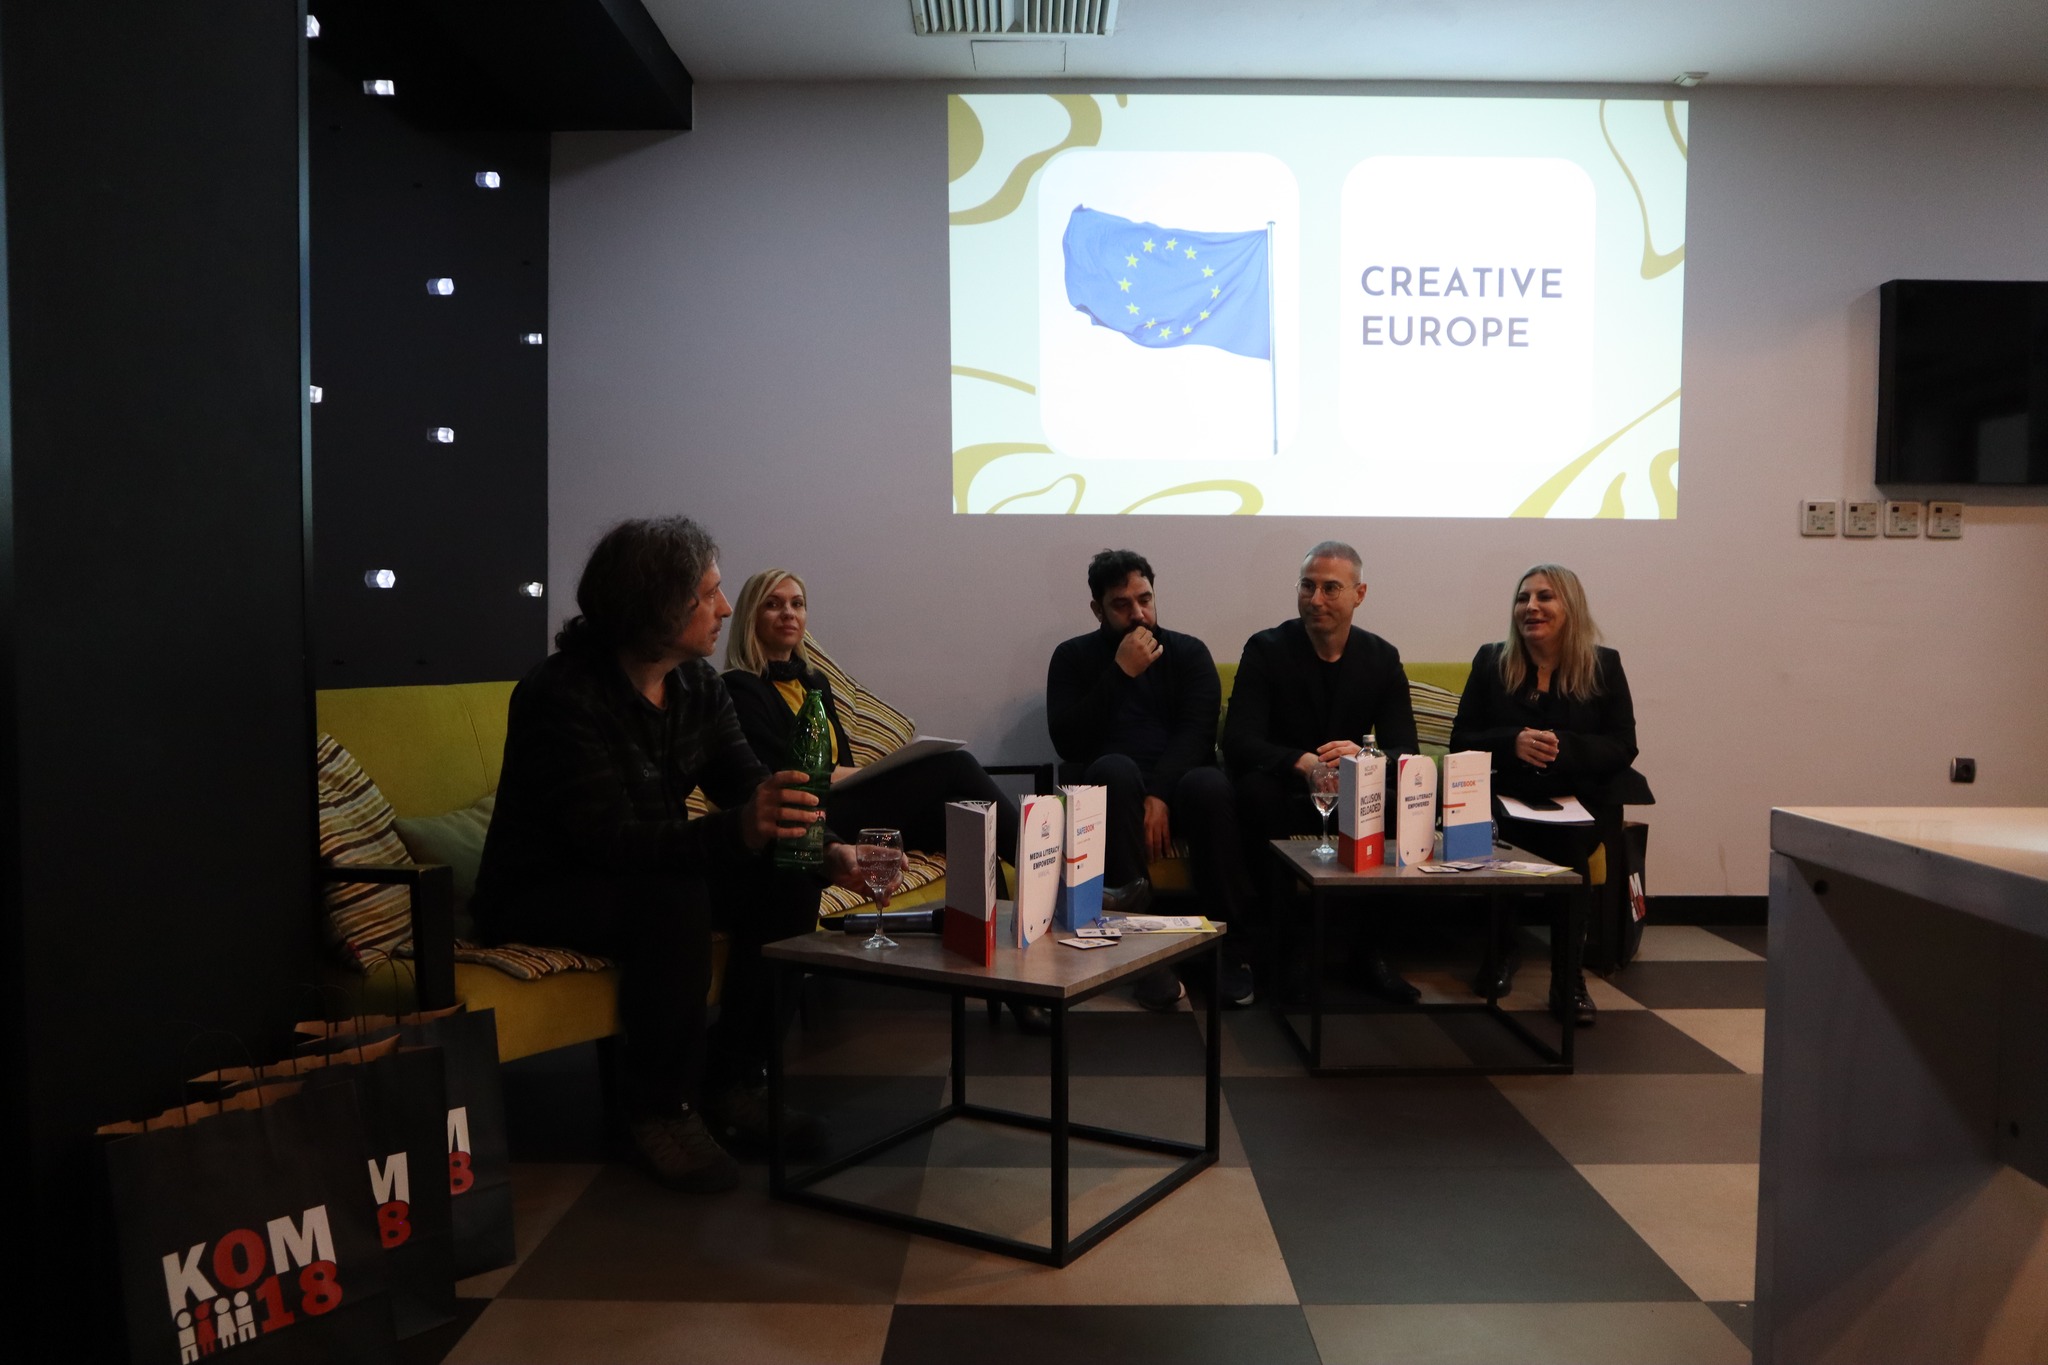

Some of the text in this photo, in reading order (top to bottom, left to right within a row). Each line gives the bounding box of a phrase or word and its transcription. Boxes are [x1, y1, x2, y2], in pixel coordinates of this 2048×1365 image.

[1361, 265, 1563, 298] CREATIVE
[1362, 315, 1529, 347] EUROPE
[1452, 780, 1476, 788] SAFEBOOK
[1360, 792, 1382, 805] INCLUSION
[1416, 792, 1433, 800] LITERACY
[1360, 803, 1381, 816] RELOADED
[1407, 800, 1430, 810] EMPOWERED
[1076, 824, 1095, 837] SAFEBOOK
[1029, 845, 1060, 861] MEDIA LITERACY
[1033, 856, 1056, 870] EMPOWERED
[162, 1204, 337, 1322] KOM
[255, 1259, 343, 1334] 18
